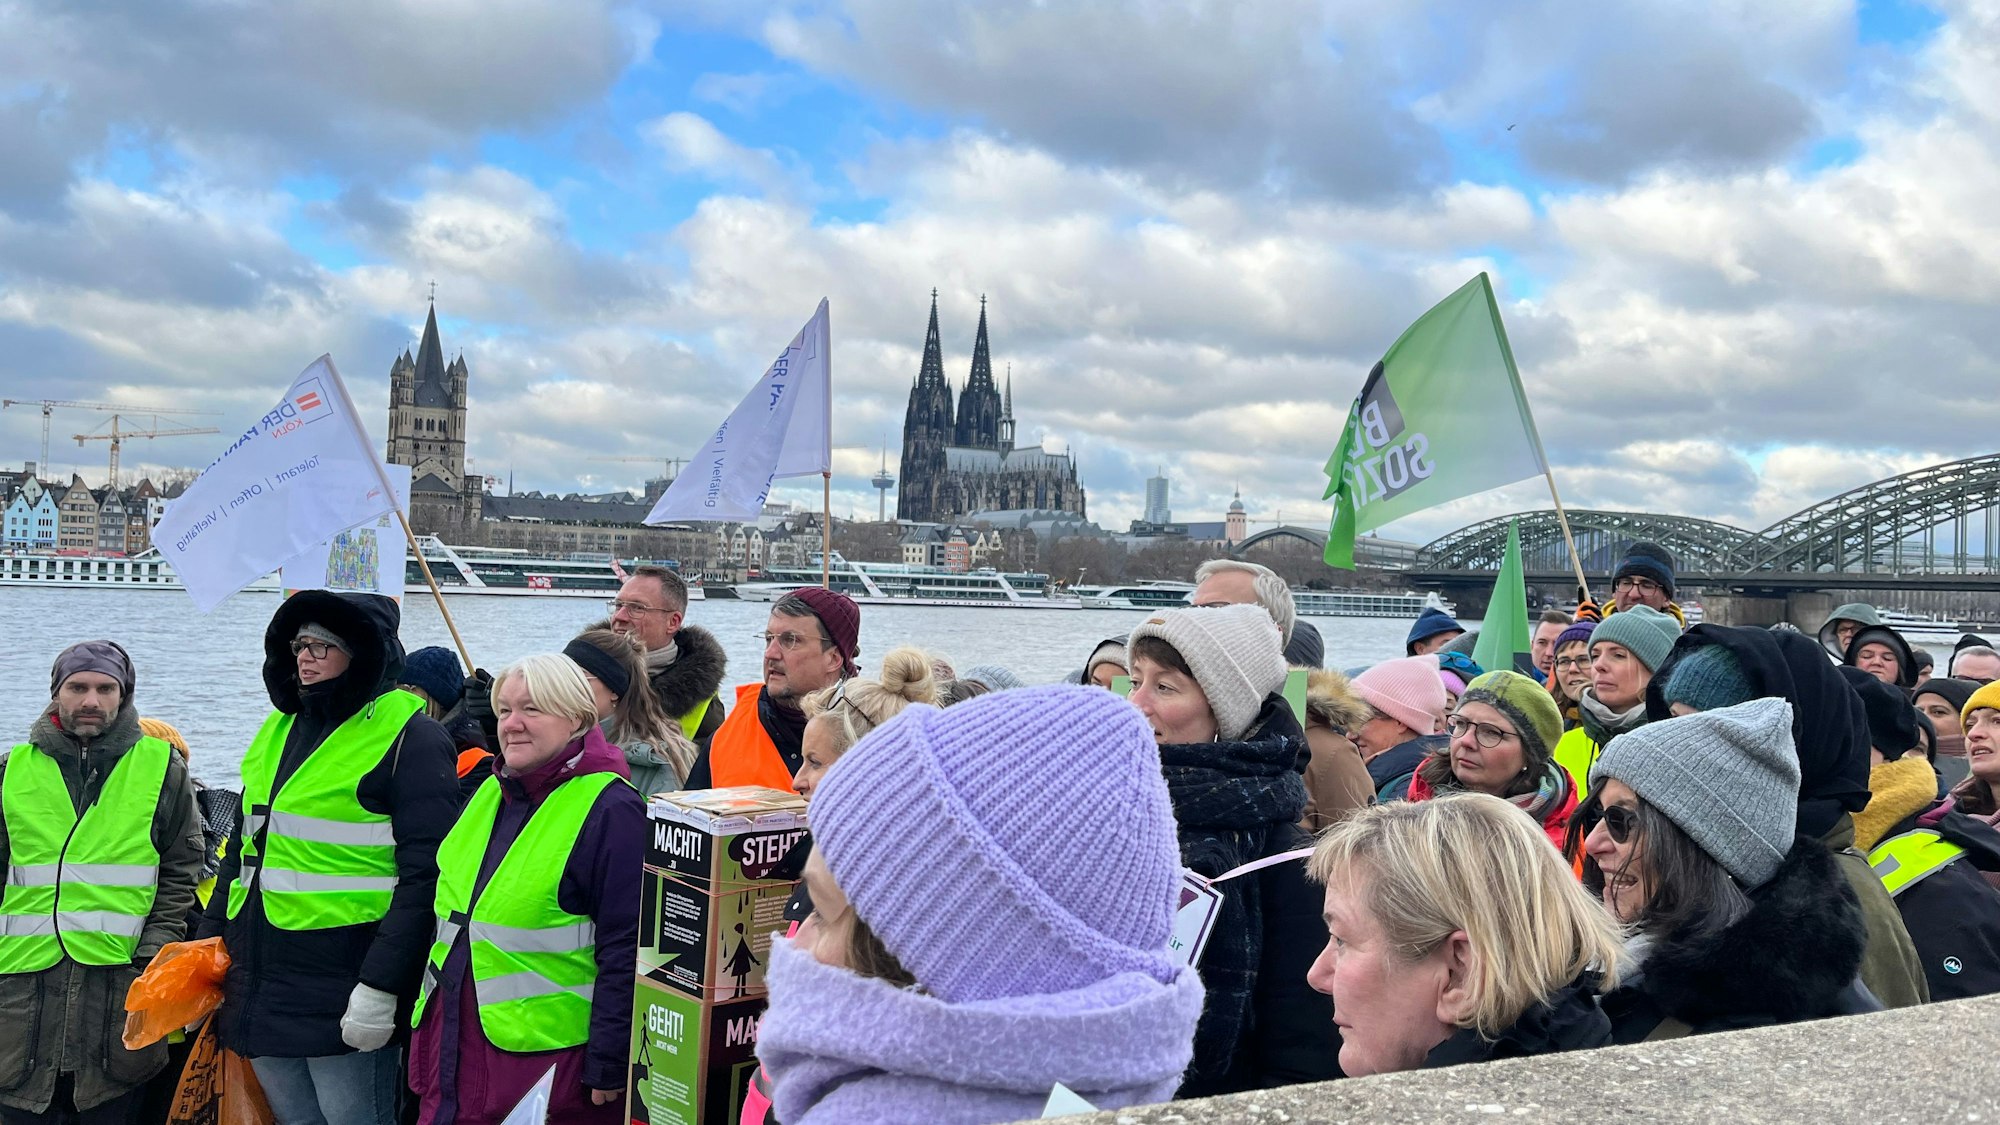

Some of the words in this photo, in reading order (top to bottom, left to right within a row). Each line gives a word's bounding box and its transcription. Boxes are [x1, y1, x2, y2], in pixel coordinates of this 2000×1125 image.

[704, 457, 725, 508] Vielfältig
[654, 822, 702, 862] MACHT!
[742, 831, 808, 866] STEHT
[1169, 934, 1183, 951] ür
[648, 1003, 685, 1043] GEHT!
[726, 1015, 757, 1048] MA
